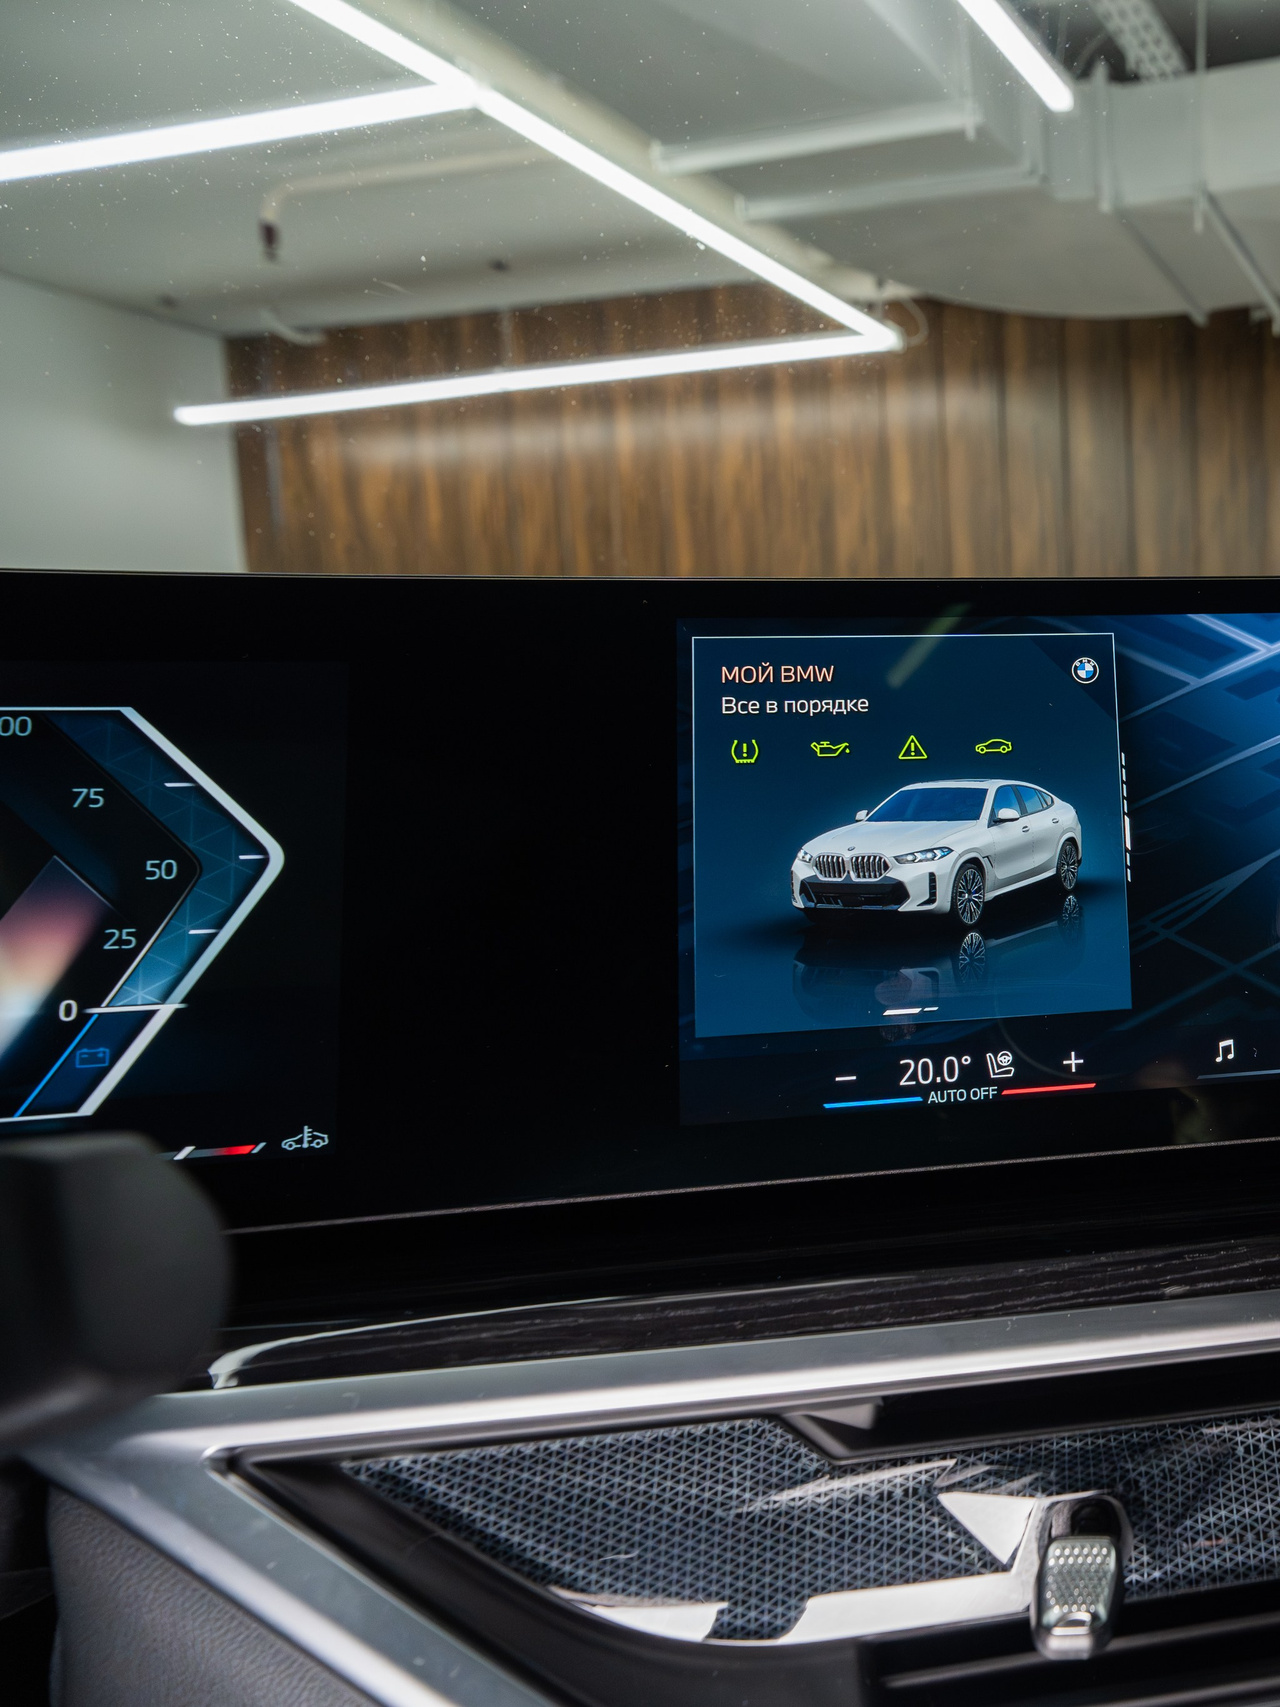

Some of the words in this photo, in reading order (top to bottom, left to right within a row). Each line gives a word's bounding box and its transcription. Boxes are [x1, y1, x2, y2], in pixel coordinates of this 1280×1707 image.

[721, 662, 774, 684] МОЙ
[780, 665, 834, 683] BMW
[721, 697, 760, 714] Все
[766, 700, 778, 713] в
[784, 698, 869, 717] порядке
[72, 787, 104, 809] 75
[145, 859, 178, 881] 50
[103, 928, 137, 950] 25
[58, 999, 78, 1021] 0
[899, 1055, 971, 1086] 20.0°
[928, 1088, 966, 1104] AUTO
[970, 1086, 998, 1101] OFF
